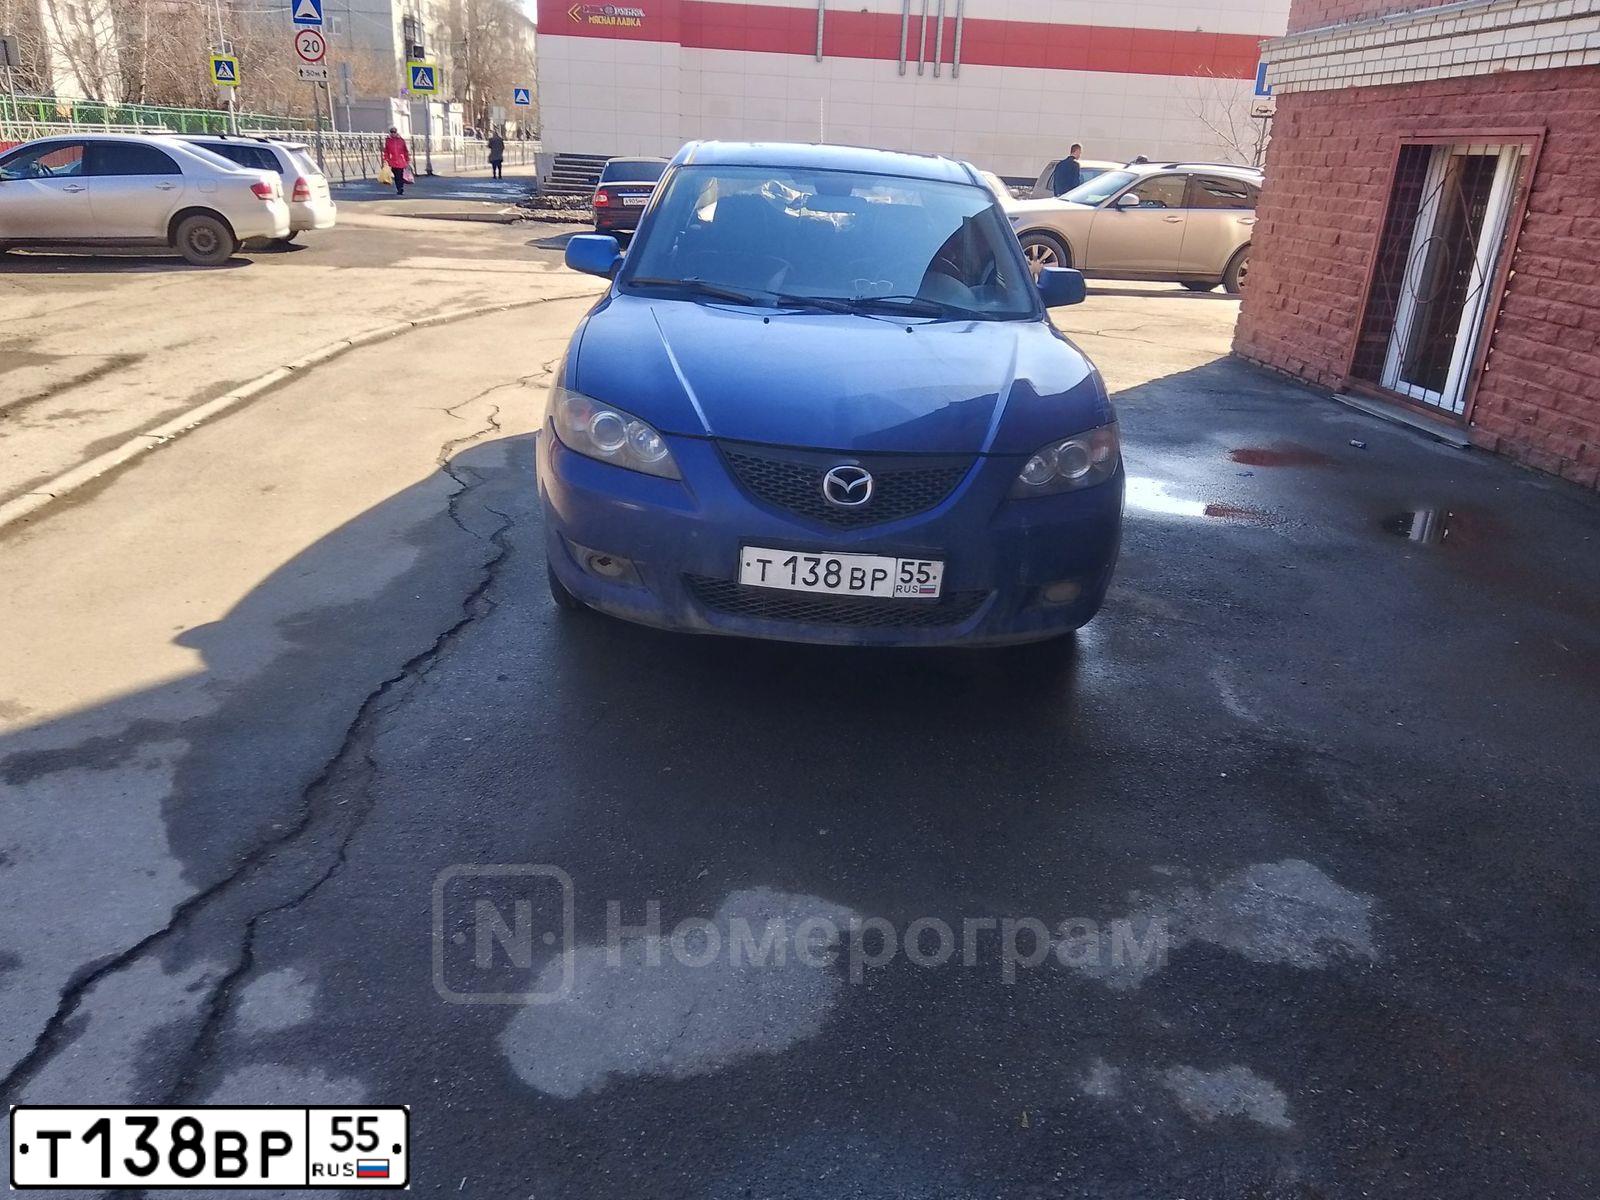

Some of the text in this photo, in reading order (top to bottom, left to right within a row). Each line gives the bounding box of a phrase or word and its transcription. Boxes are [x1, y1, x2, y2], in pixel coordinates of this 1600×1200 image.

[588, 15, 642, 27] МЯСНАЯ ЛАВКА
[302, 39, 320, 53] 20
[900, 562, 932, 584] 55
[895, 584, 919, 594] RUS
